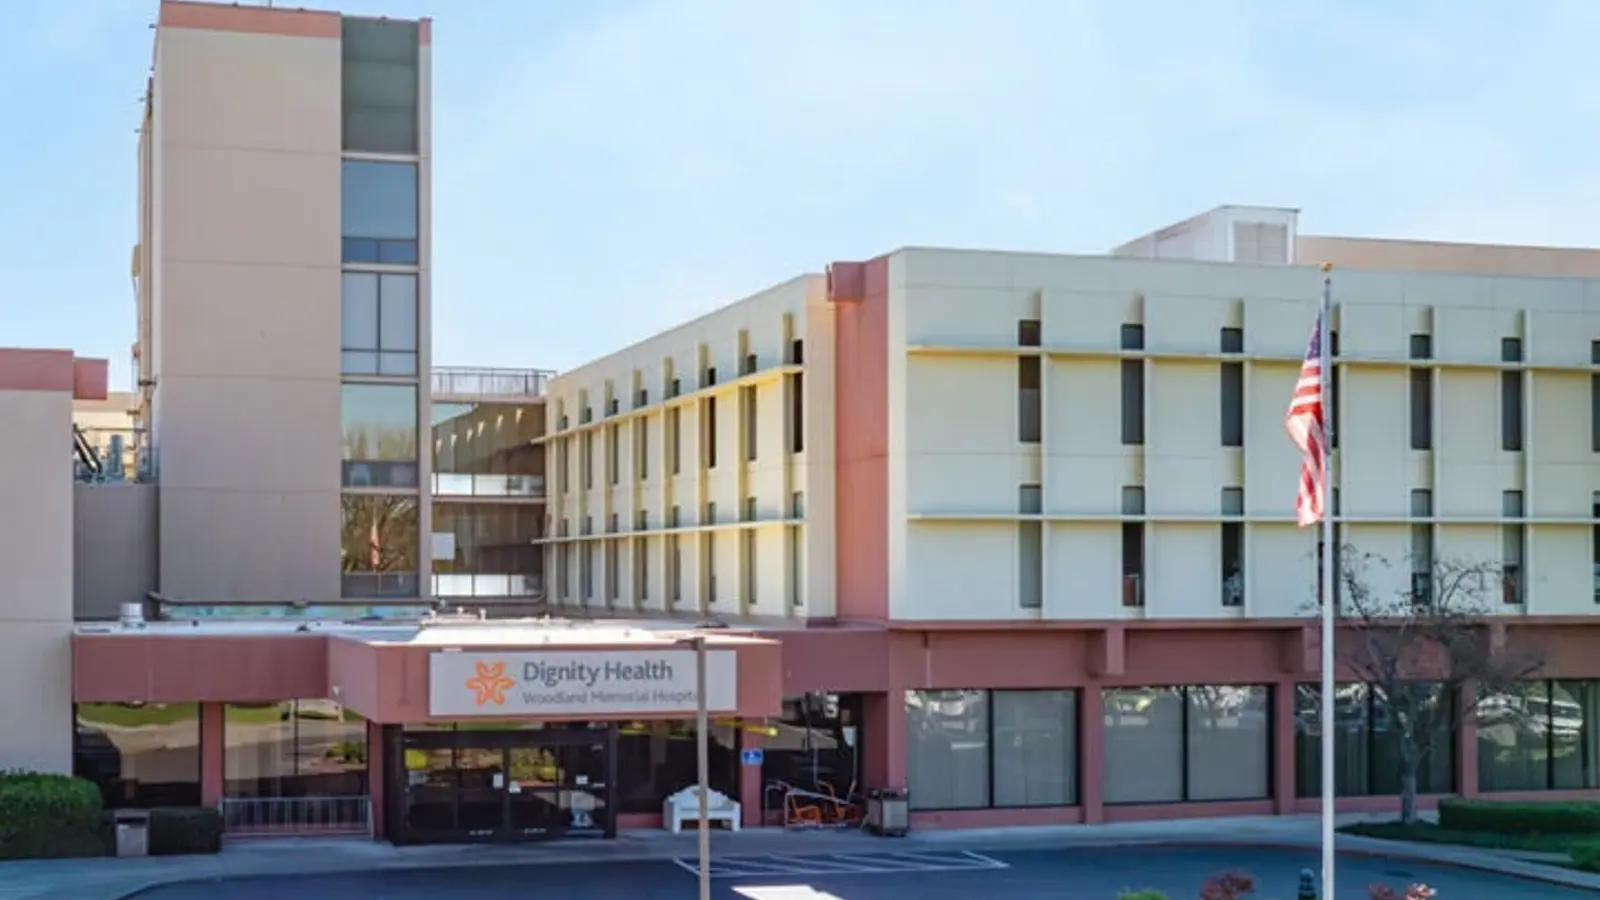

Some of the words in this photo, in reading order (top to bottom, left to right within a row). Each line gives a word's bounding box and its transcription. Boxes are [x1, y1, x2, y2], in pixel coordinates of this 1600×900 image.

[523, 660, 600, 687] Dignity
[604, 659, 673, 681] Health
[522, 690, 587, 705] Woodland
[590, 690, 650, 703] Memorial
